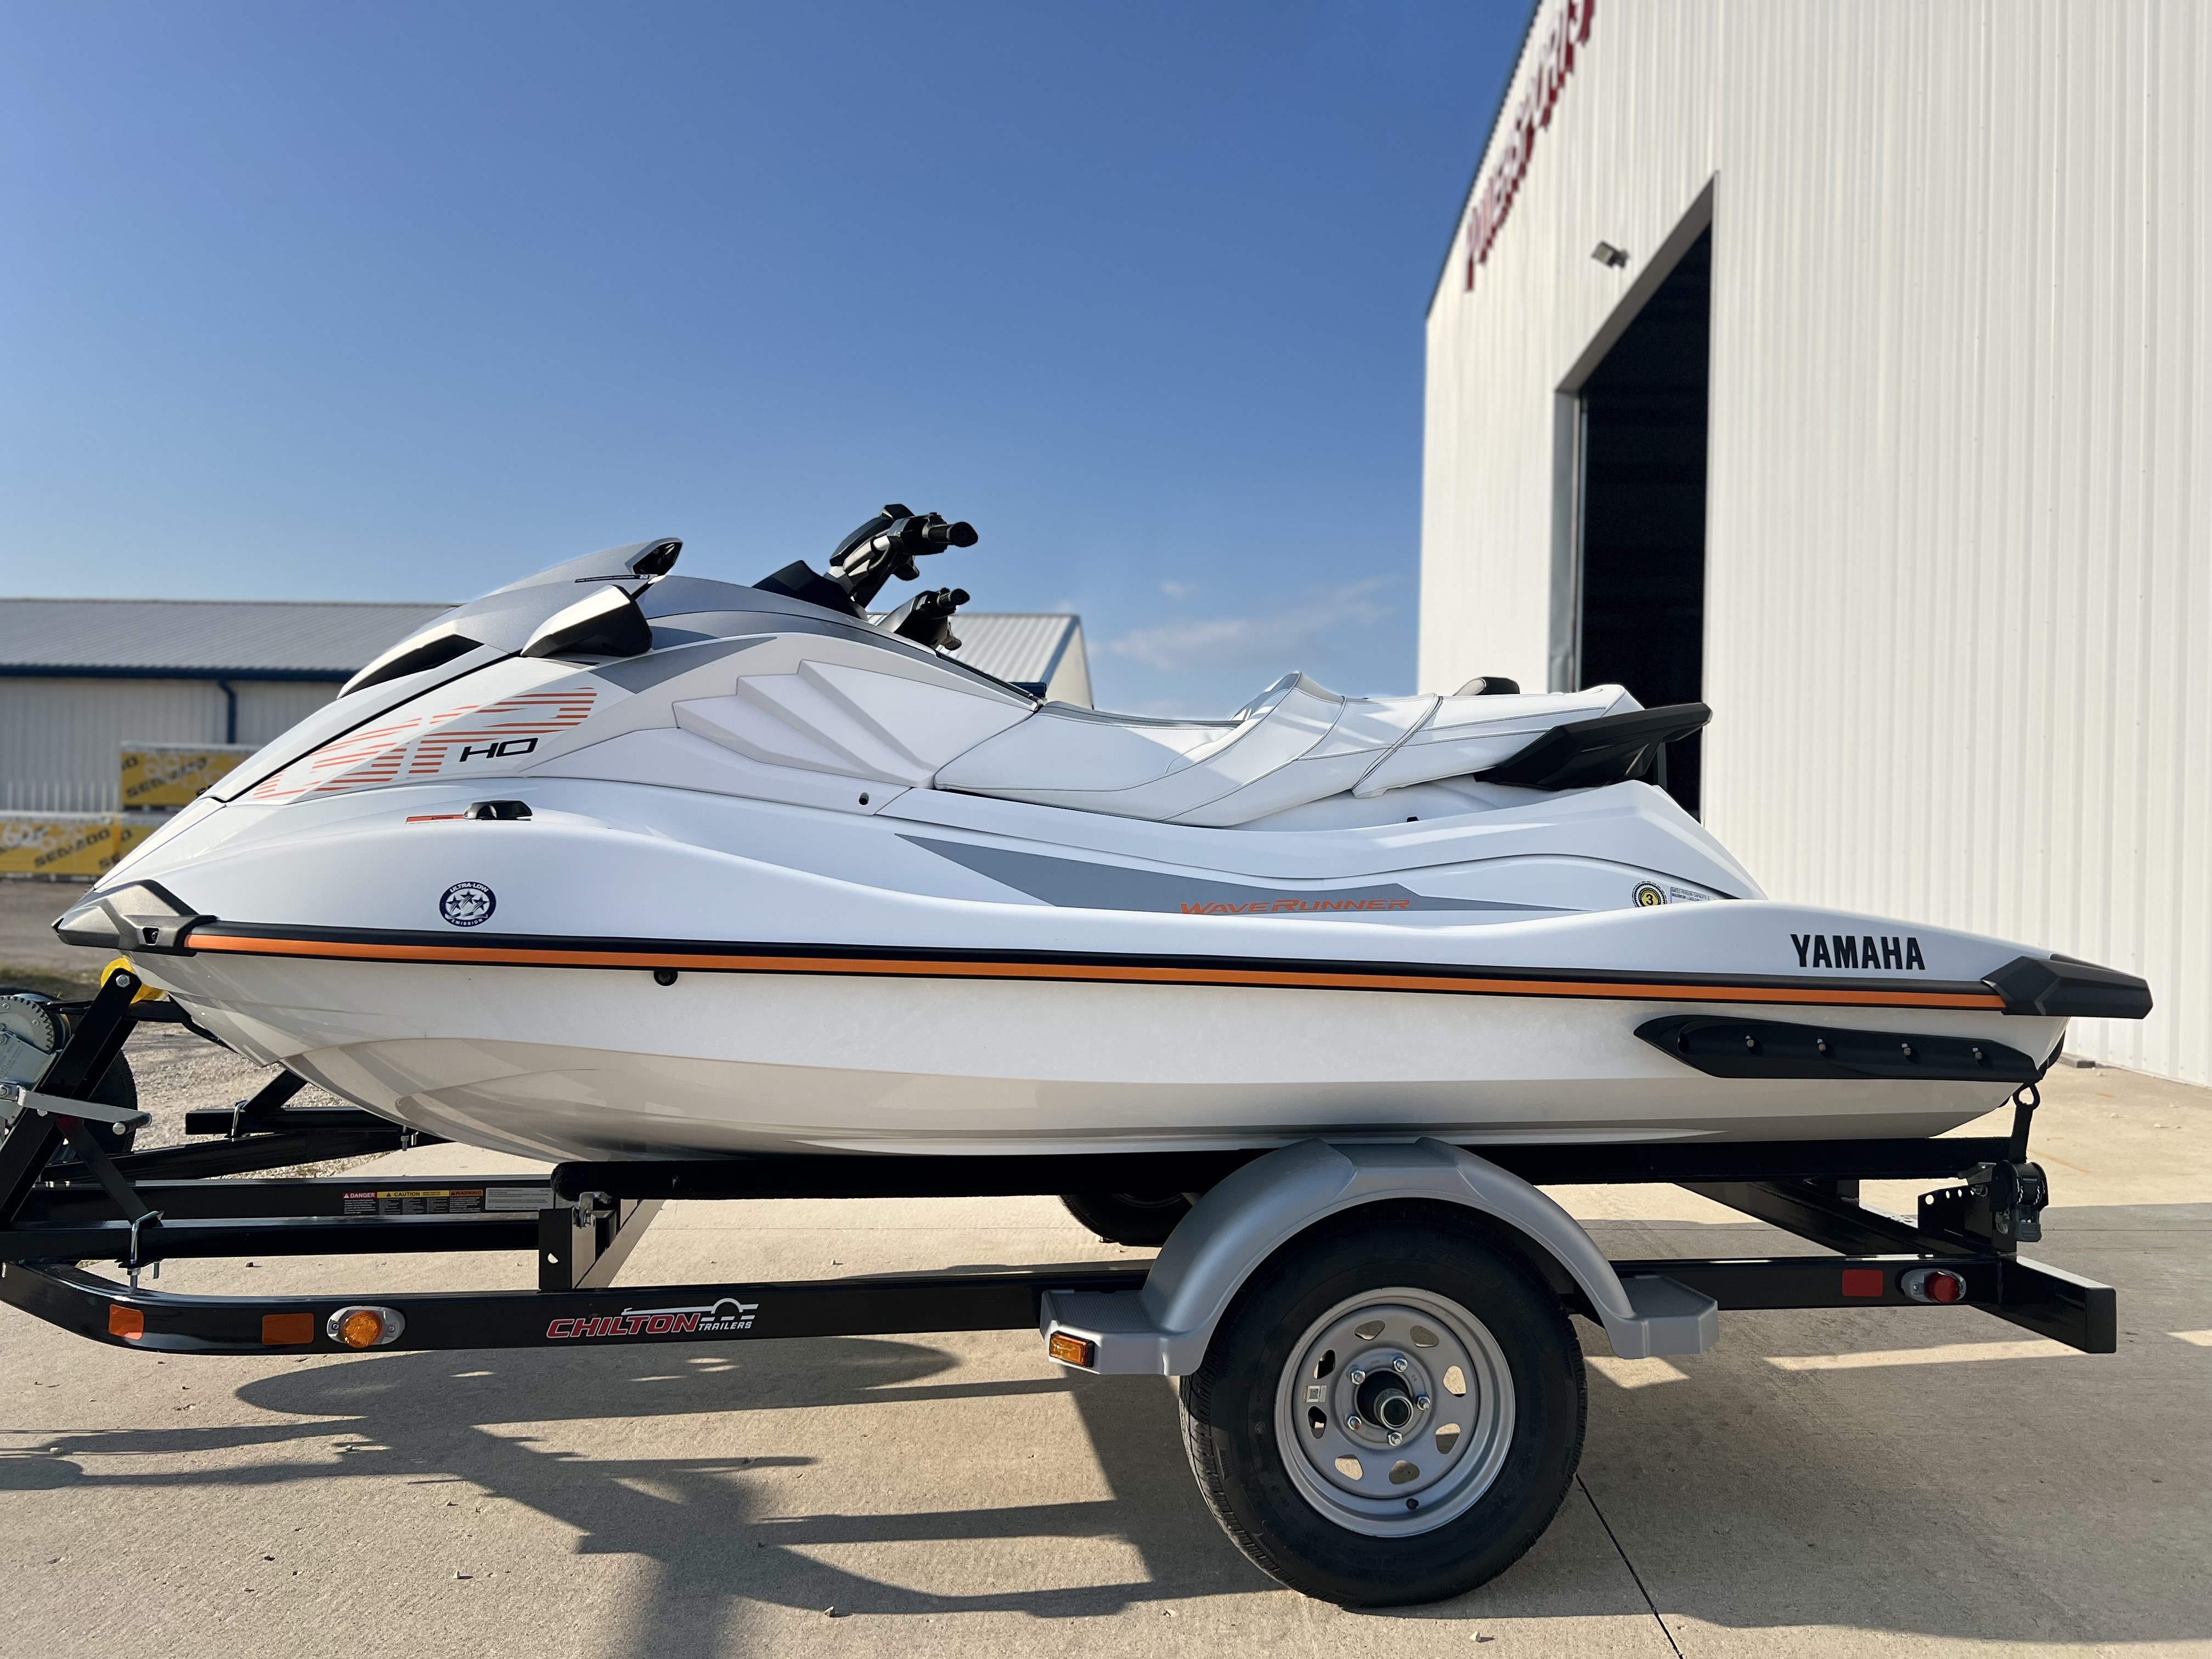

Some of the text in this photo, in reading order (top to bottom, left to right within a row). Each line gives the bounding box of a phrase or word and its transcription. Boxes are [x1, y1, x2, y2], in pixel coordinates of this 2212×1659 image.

[460, 738, 538, 762] HO
[449, 883, 489, 893] ULTRA-LOW
[1646, 894, 1654, 905] 3
[1791, 934, 1926, 970] YAMAHA
[546, 1313, 752, 1338] CHILTON TRAILERS
